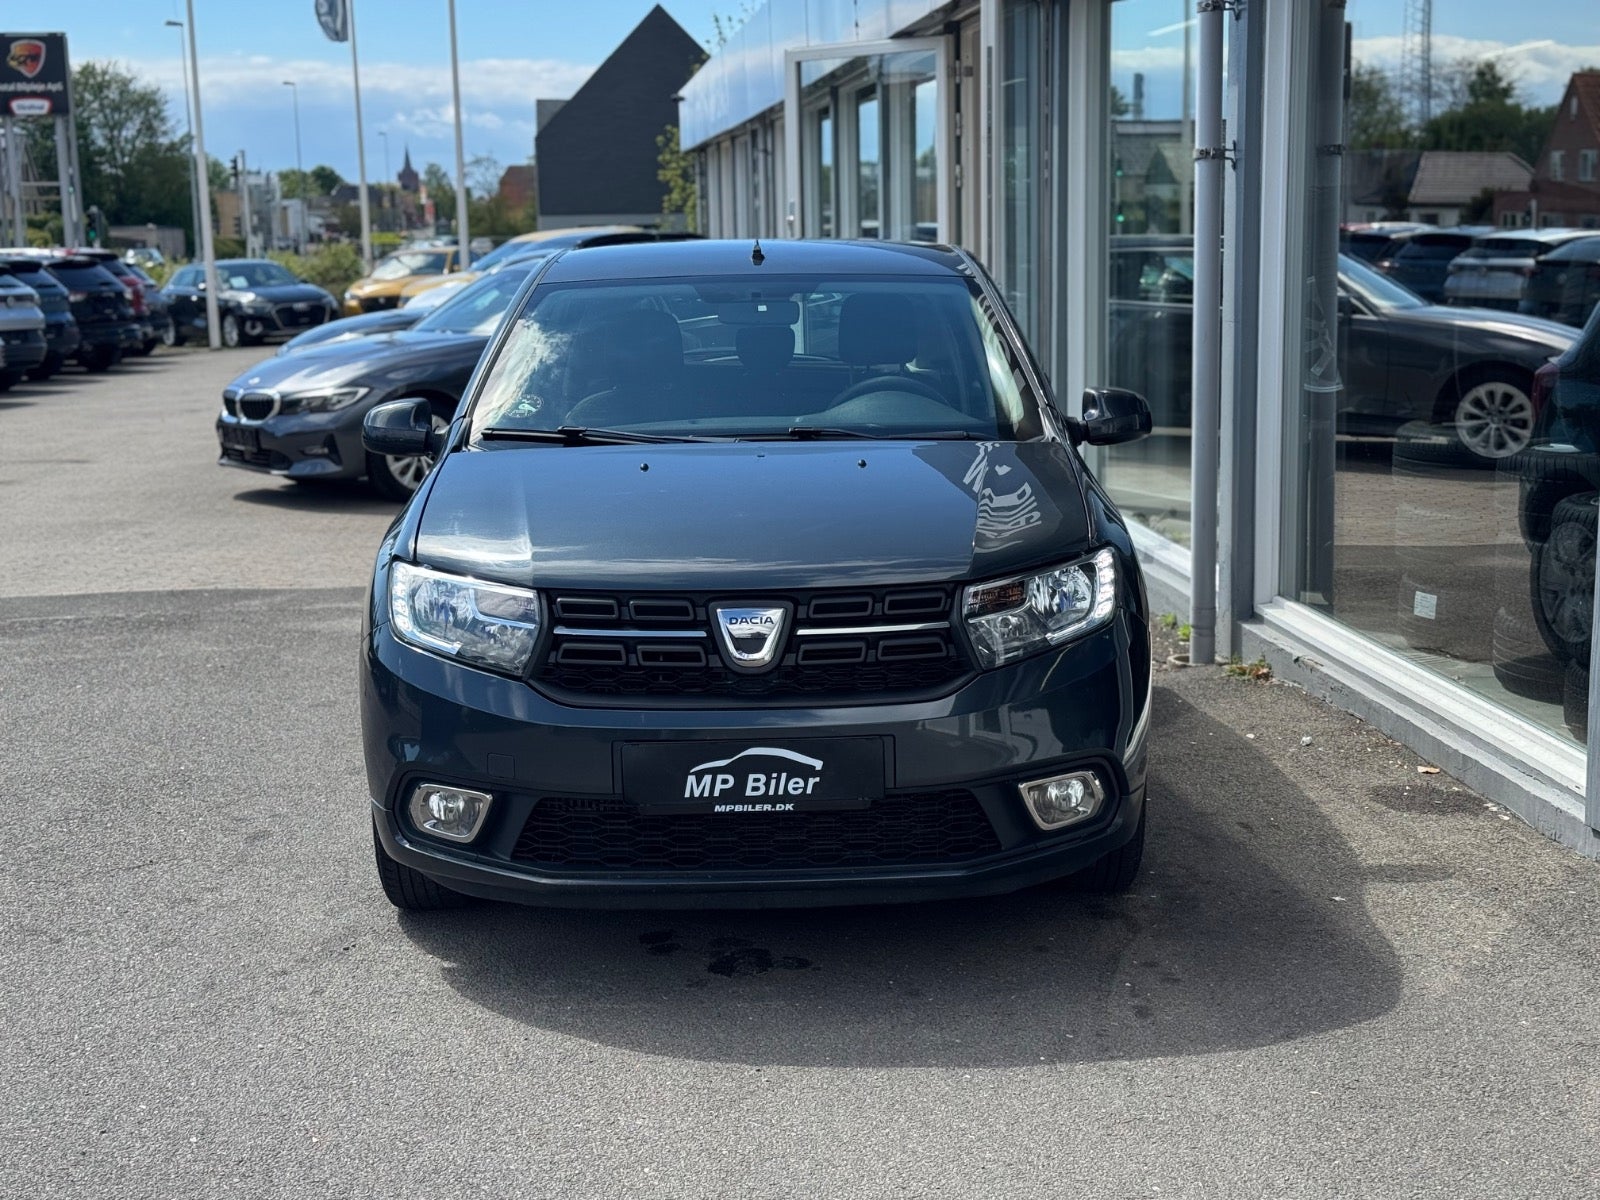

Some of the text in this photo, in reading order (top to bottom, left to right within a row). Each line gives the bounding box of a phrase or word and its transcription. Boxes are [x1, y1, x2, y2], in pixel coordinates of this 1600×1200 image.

[728, 616, 775, 625] DACIA
[684, 773, 820, 798] MP Biler
[714, 803, 795, 813] MPBILER.DK
